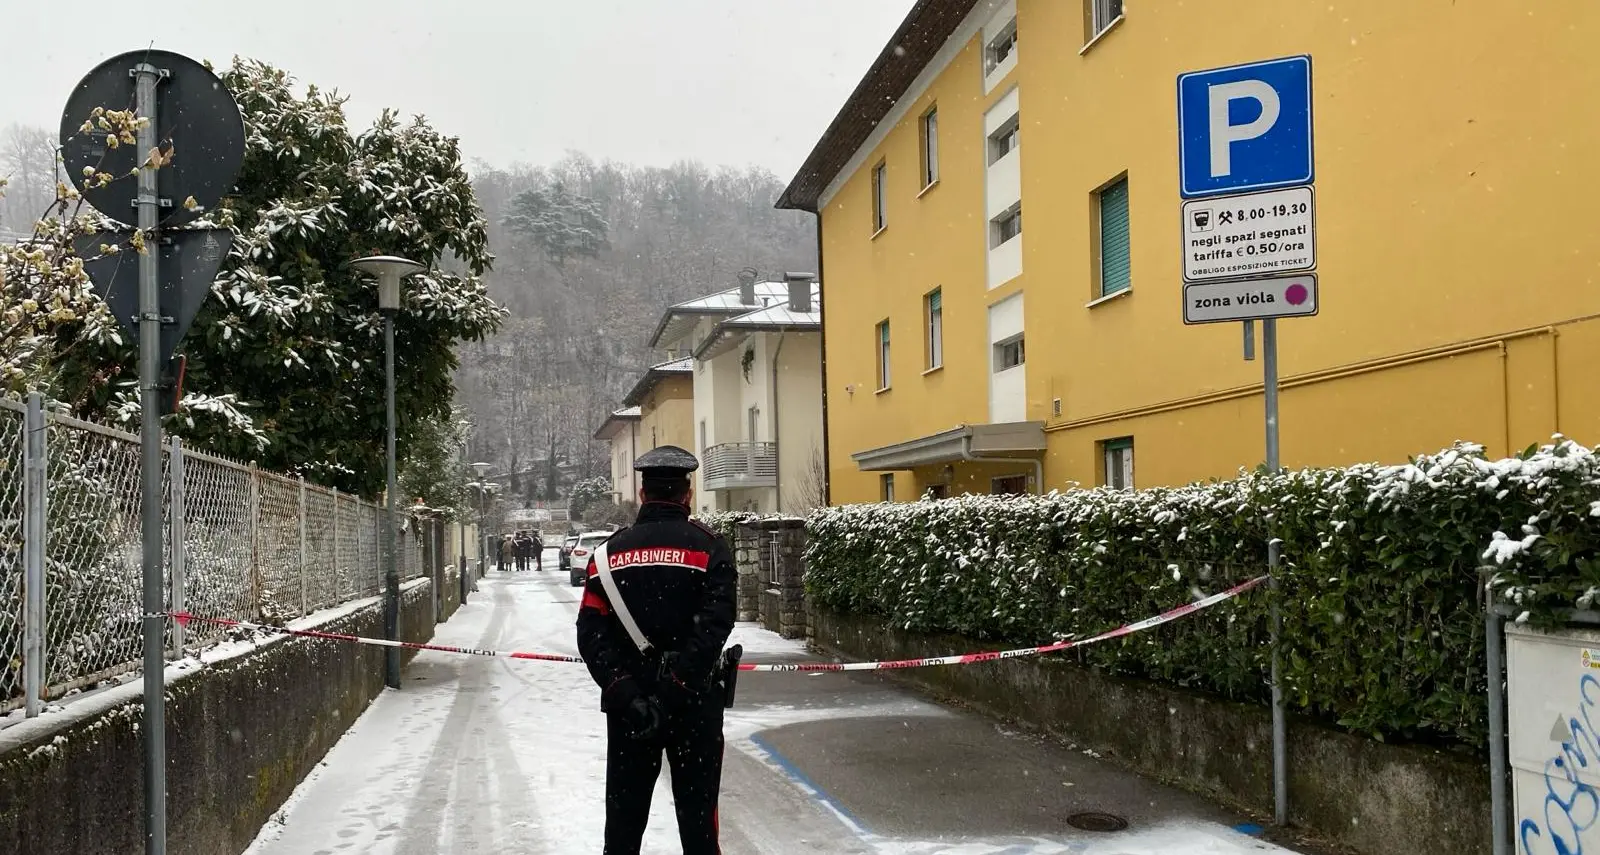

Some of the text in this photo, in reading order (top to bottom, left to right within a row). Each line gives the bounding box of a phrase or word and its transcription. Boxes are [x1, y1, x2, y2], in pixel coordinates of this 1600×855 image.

[1208, 79, 1281, 178] P
[1191, 225, 1307, 248] negli spazi segnati
[1194, 249, 1233, 261] tariffa
[1192, 257, 1308, 275] OBBLIGO ESPOSIZIONE TICKET
[1195, 291, 1275, 309] zona viola
[609, 550, 685, 568] CARABINIERI
